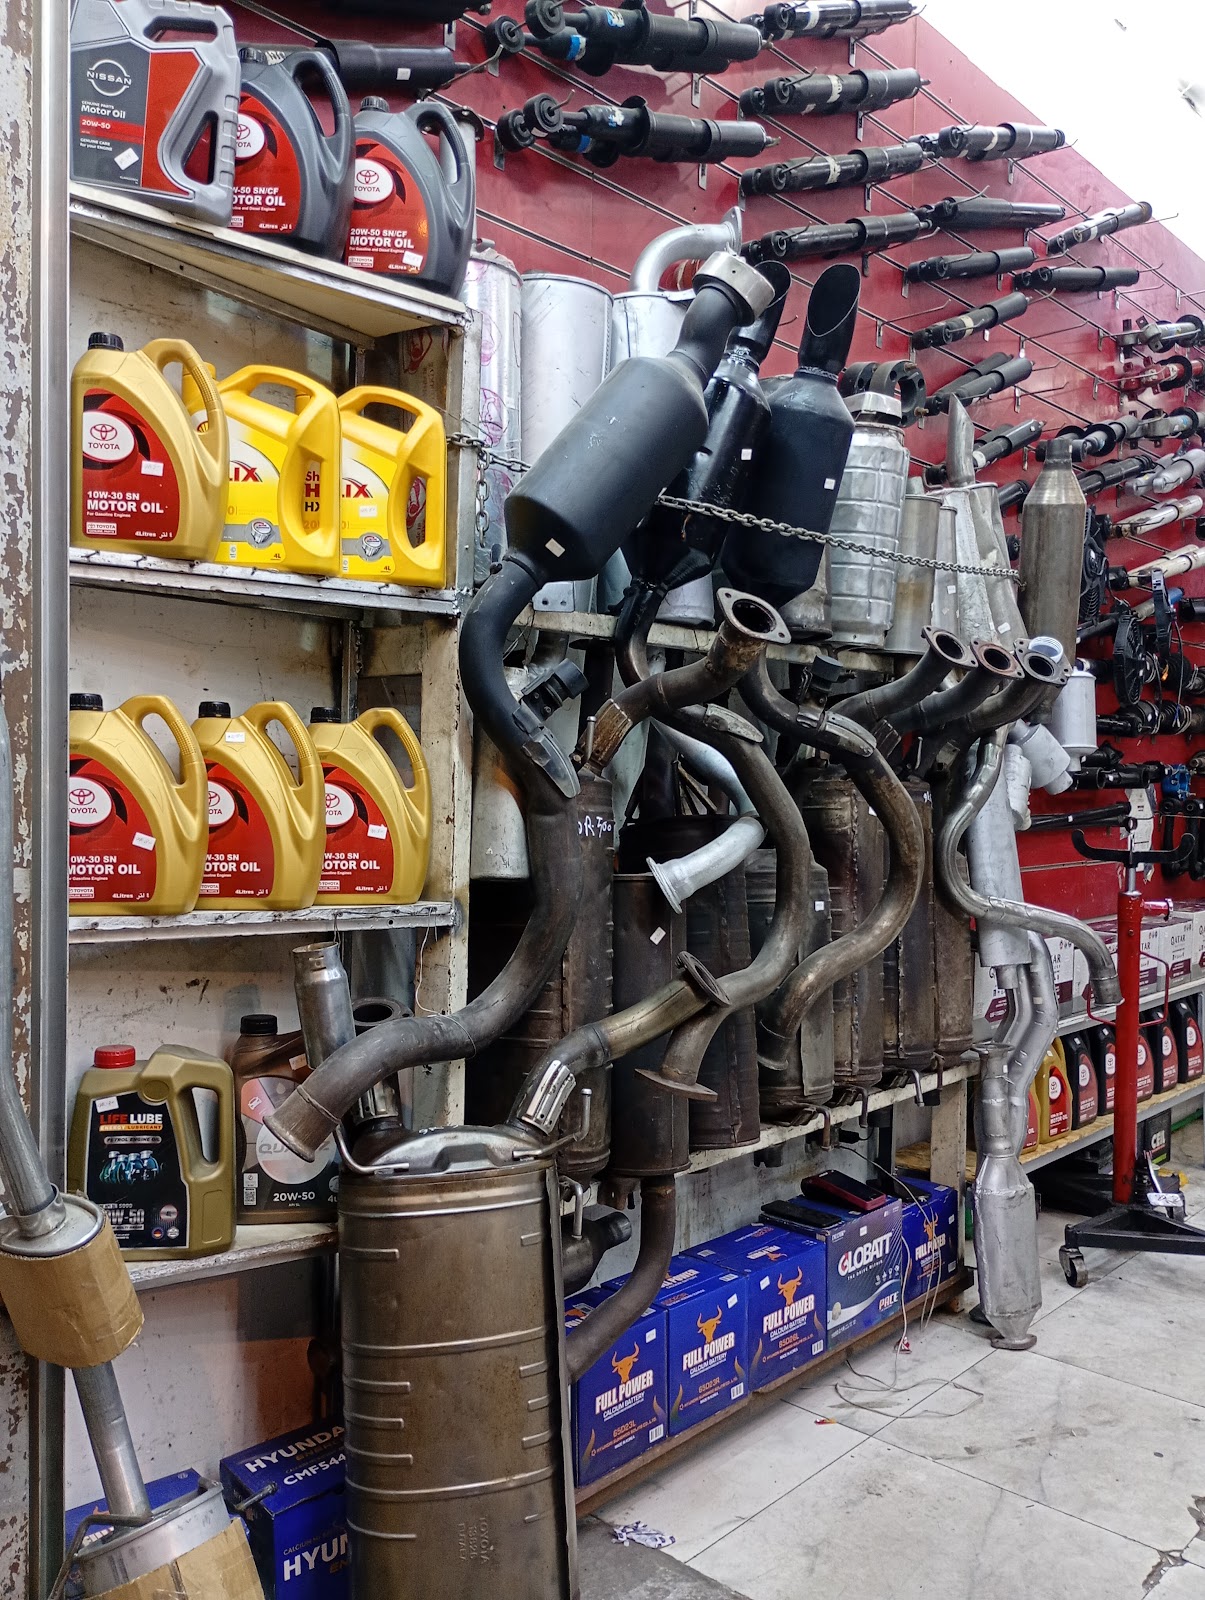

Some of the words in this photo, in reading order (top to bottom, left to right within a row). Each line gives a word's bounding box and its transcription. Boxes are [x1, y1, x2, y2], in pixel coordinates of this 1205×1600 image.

[86, 71, 132, 85] NISSAN
[81, 104, 112, 116] Motor
[112, 110, 126, 119] Oil
[82, 120, 111, 130] 20W-50
[253, 186, 279, 195] SN/CF
[232, 195, 262, 206] OTOR
[265, 196, 286, 206] OIL
[350, 228, 380, 236] 20W-50
[382, 230, 407, 238] SN/CF
[350, 236, 391, 247] MOTOR
[394, 238, 414, 249] OIL
[88, 442, 120, 450] TOYOTA
[87, 491, 123, 499] 10W-30
[87, 500, 137, 512] MOTOR
[141, 502, 164, 513] OIL
[118, 864, 141, 875] OIL
[205, 862, 237, 871] OTOR
[240, 862, 261, 872] OIL
[322, 860, 357, 870] OTOR
[360, 860, 380, 870] OIL
[1141, 942, 1150, 950] TAR
[100, 1114, 128, 1124] LIFE
[130, 1114, 162, 1124] LUBE
[273, 1191, 316, 1201] 20W-50
[838, 1232, 892, 1276] GLOBATT
[879, 1292, 899, 1310] PACE
[763, 1309, 783, 1334] FULL
[784, 1294, 815, 1321] POWER
[770, 1324, 789, 1338] CALCIUM
[789, 1315, 807, 1329] BATTERY
[683, 1349, 703, 1371] FULL
[704, 1332, 735, 1358] POWER
[690, 1361, 708, 1375] CALCIUM
[595, 1389, 617, 1415] FULL
[619, 1369, 654, 1402] POWER
[603, 1402, 625, 1419] CALCIUM
[625, 1391, 645, 1408] BATTERY
[245, 1426, 345, 1473] HYUNDA
